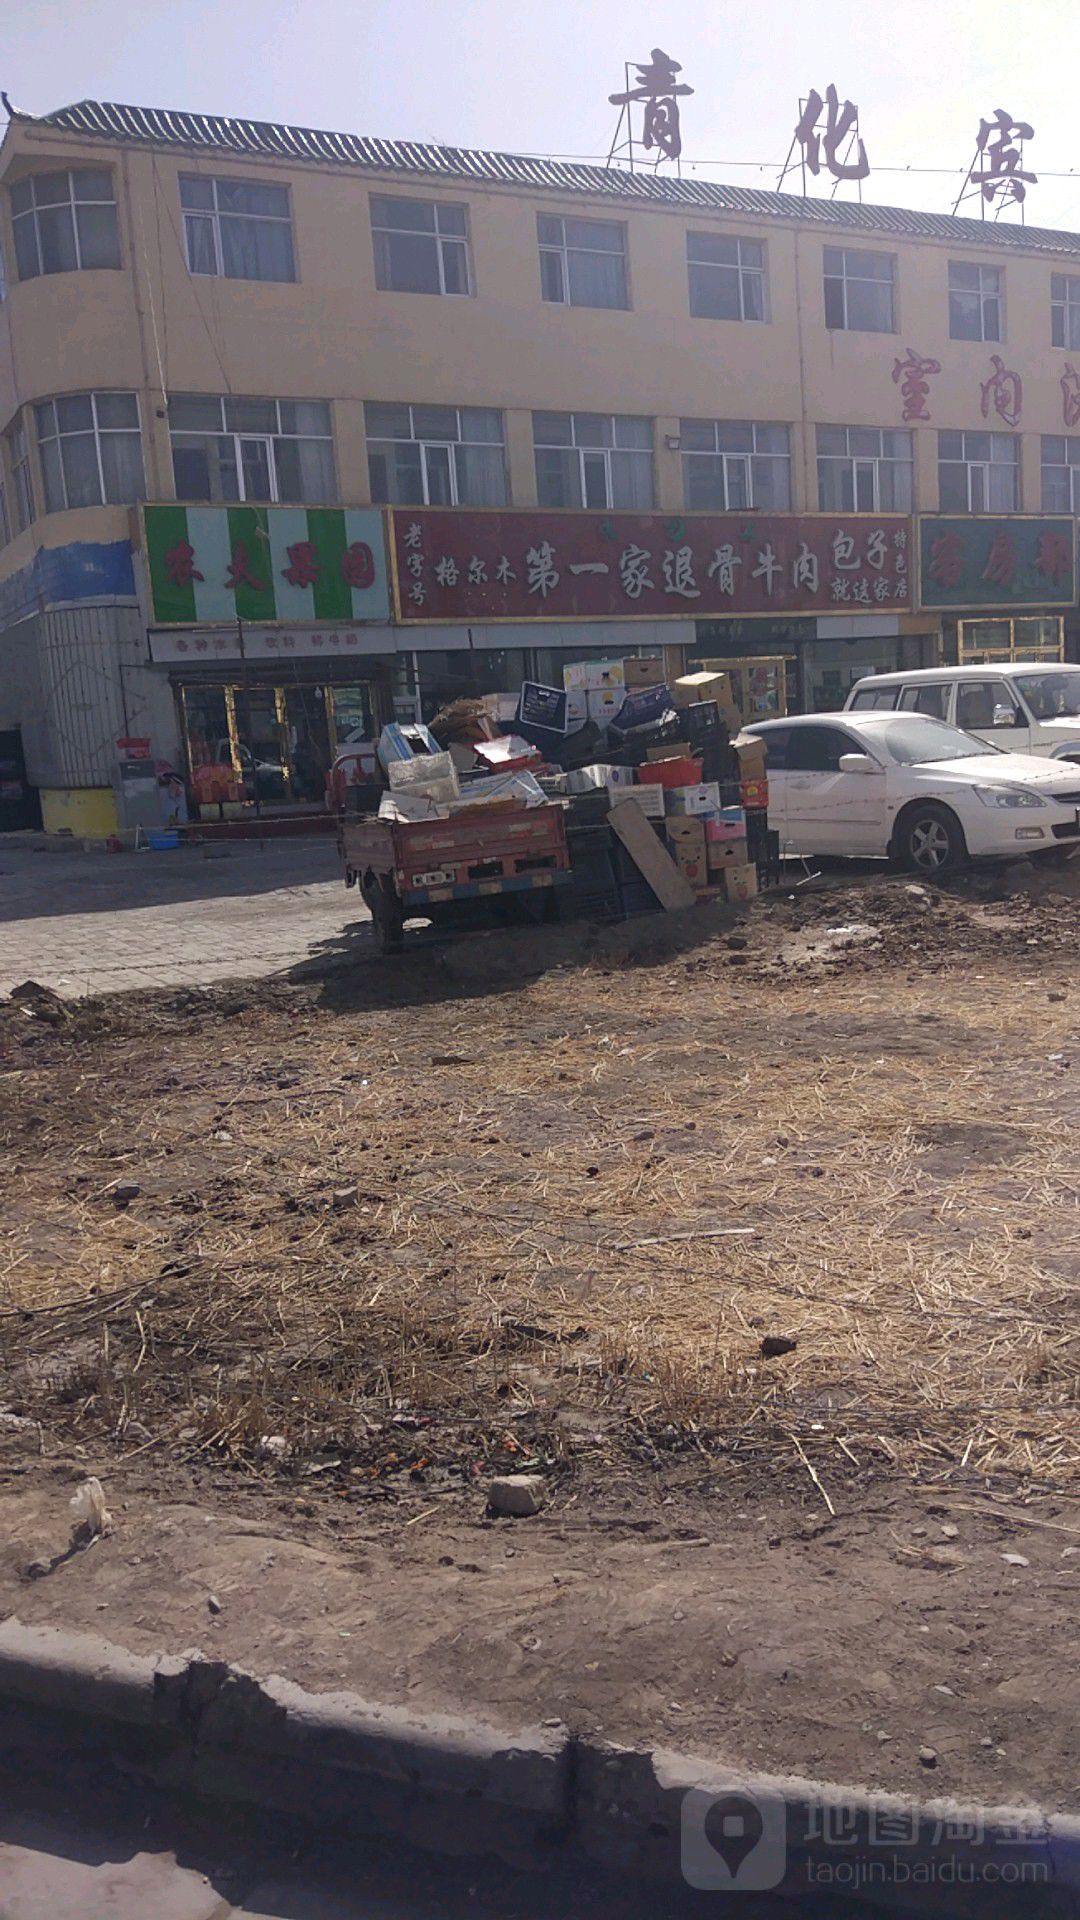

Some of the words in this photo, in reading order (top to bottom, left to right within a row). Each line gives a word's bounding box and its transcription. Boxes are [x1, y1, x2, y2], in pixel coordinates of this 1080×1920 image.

[404, 523, 427, 606] 老字号
[893, 528, 908, 599] 特色店
